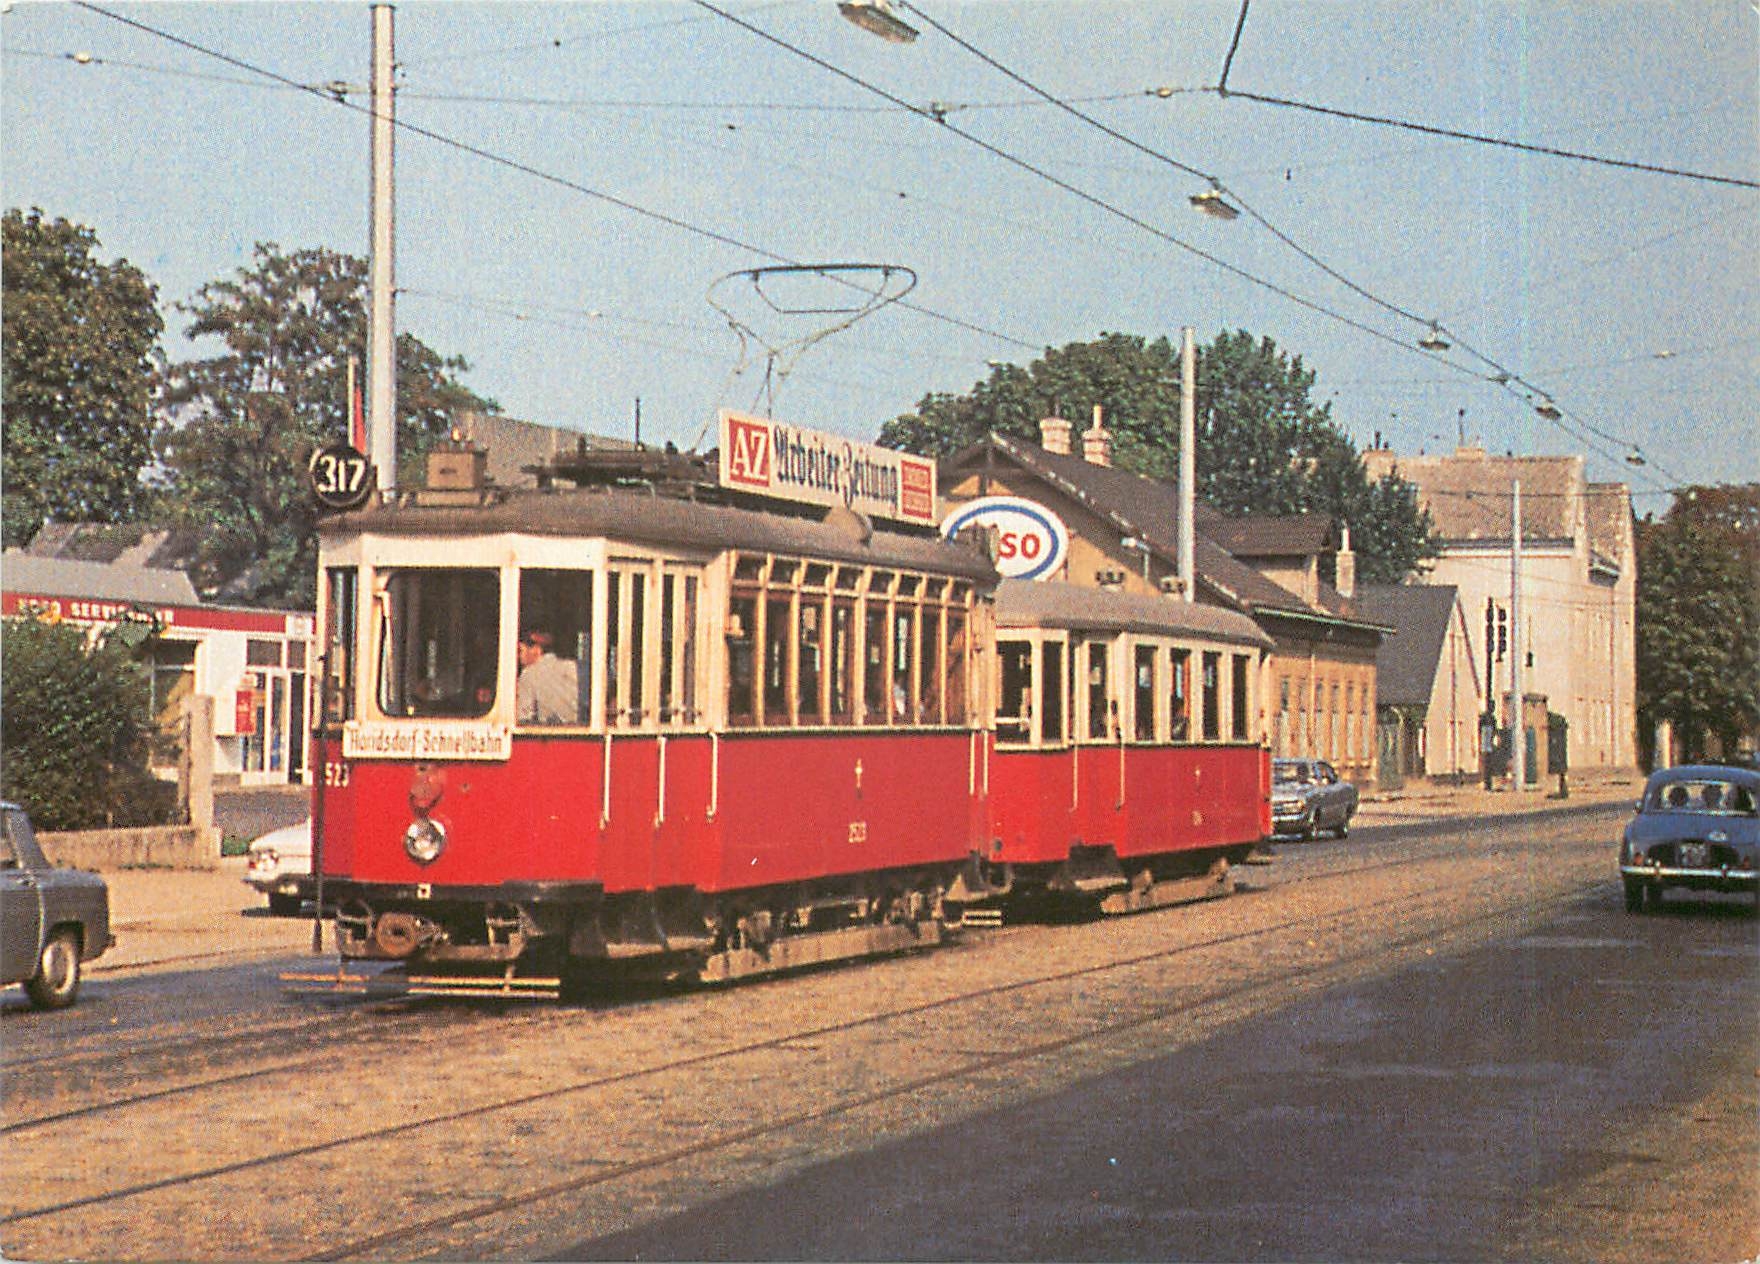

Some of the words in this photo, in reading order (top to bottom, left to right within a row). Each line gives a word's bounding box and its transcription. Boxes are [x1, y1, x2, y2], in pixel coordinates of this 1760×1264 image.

[731, 426, 768, 480] AZ
[318, 455, 365, 492] 317
[999, 532, 1041, 560] SO
[325, 762, 350, 788] 523
